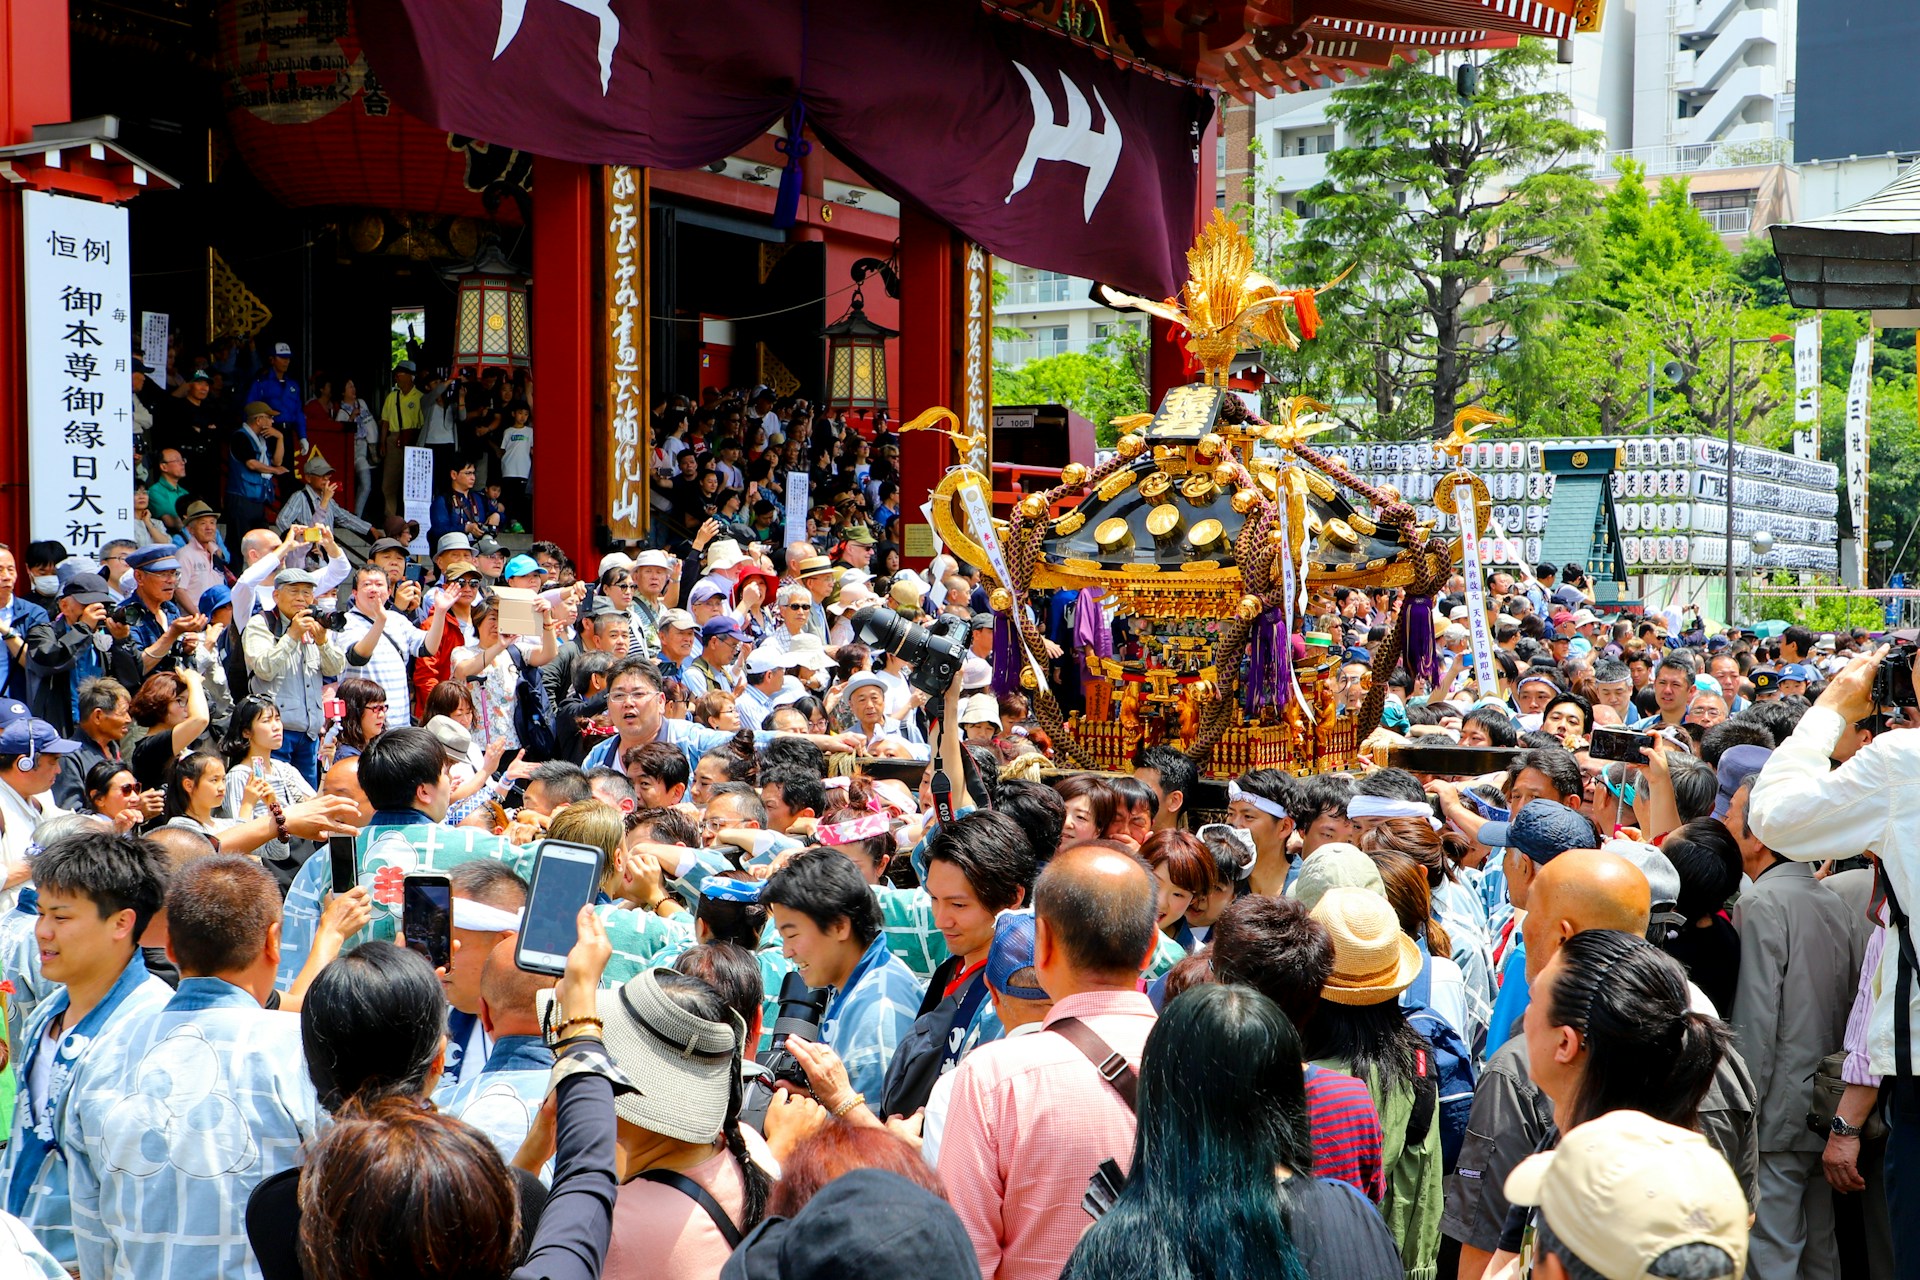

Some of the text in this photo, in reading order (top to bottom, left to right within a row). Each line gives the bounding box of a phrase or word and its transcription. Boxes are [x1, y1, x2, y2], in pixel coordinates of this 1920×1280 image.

[46, 230, 110, 265] 恒例
[112, 308, 130, 521] 毎月十八日
[973, 505, 986, 527] 令和
[1461, 504, 1472, 525] 令和
[1466, 532, 1474, 551] 奉祝
[1473, 608, 1491, 681] 天皇陛下御即位
[938, 802, 951, 822] 60D
